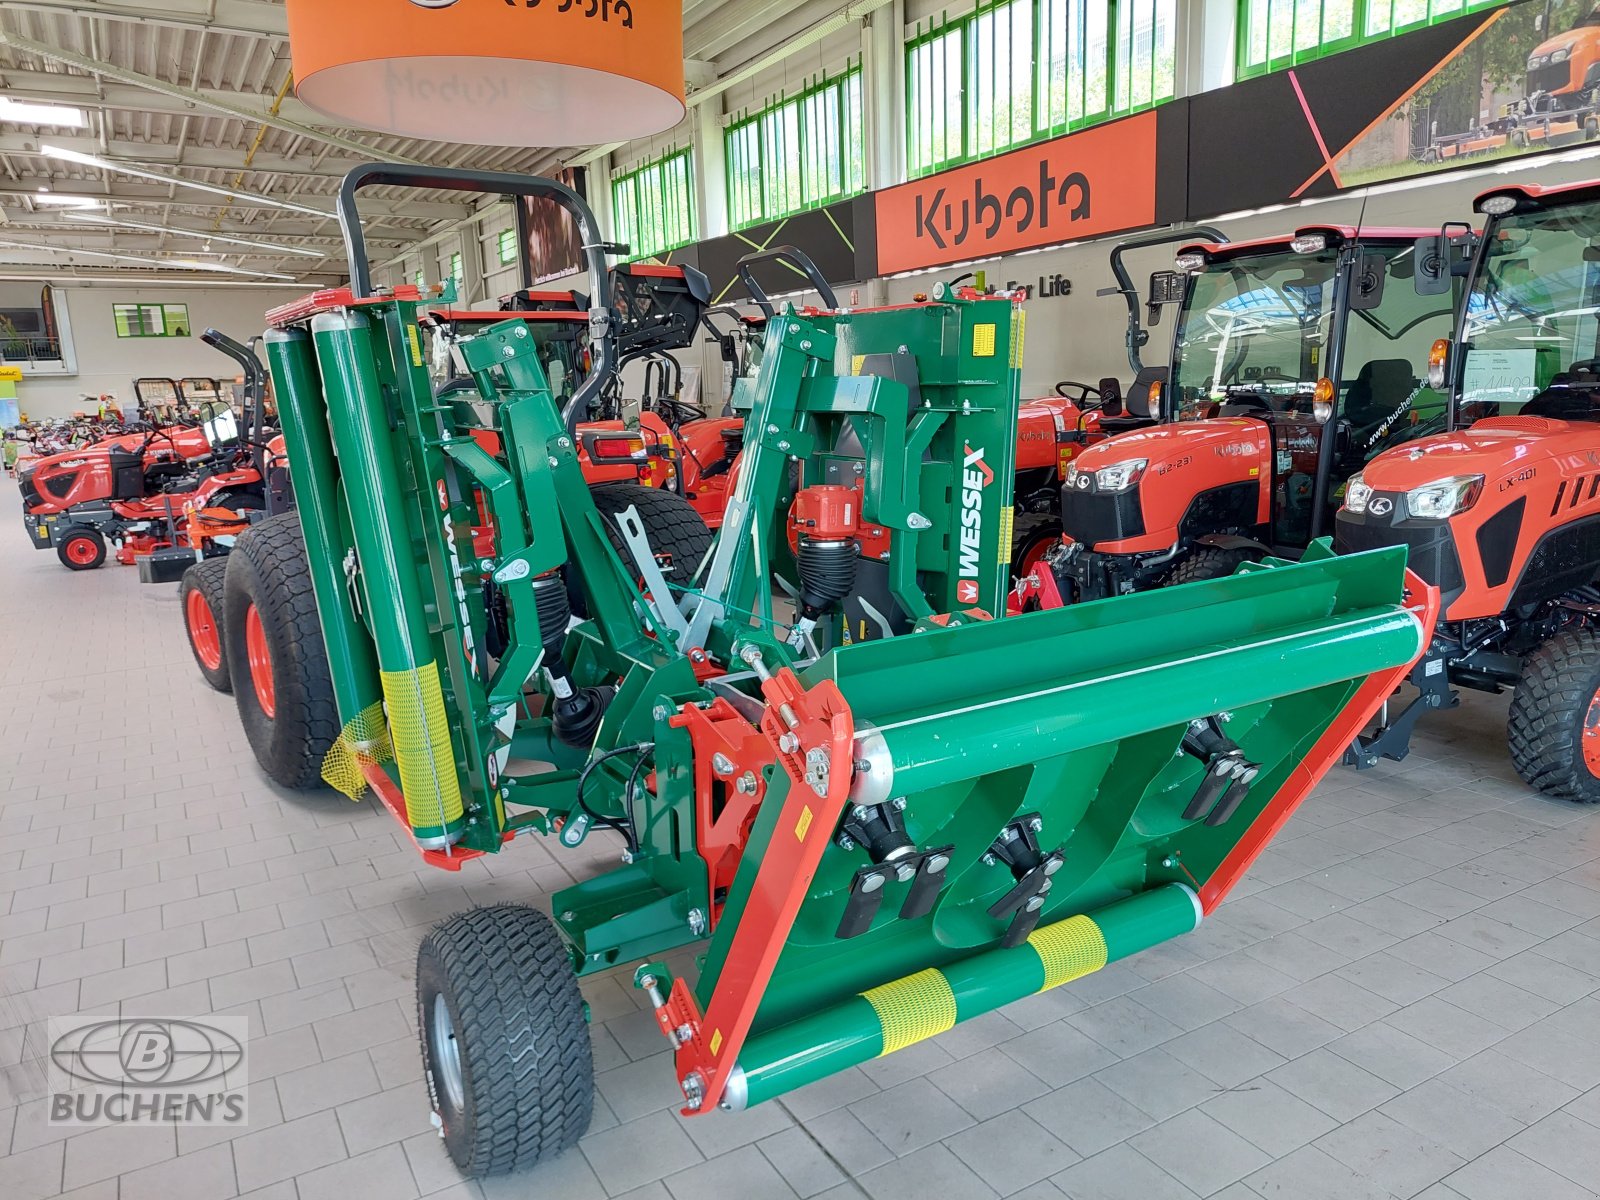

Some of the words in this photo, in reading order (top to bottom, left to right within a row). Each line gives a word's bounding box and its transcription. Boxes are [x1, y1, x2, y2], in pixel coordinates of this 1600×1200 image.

[915, 158, 1091, 249] Kubota
[1039, 273, 1072, 298] Life
[1213, 443, 1253, 457] Kubota
[1499, 468, 1536, 492] LX-401
[958, 443, 994, 577] WESSEX
